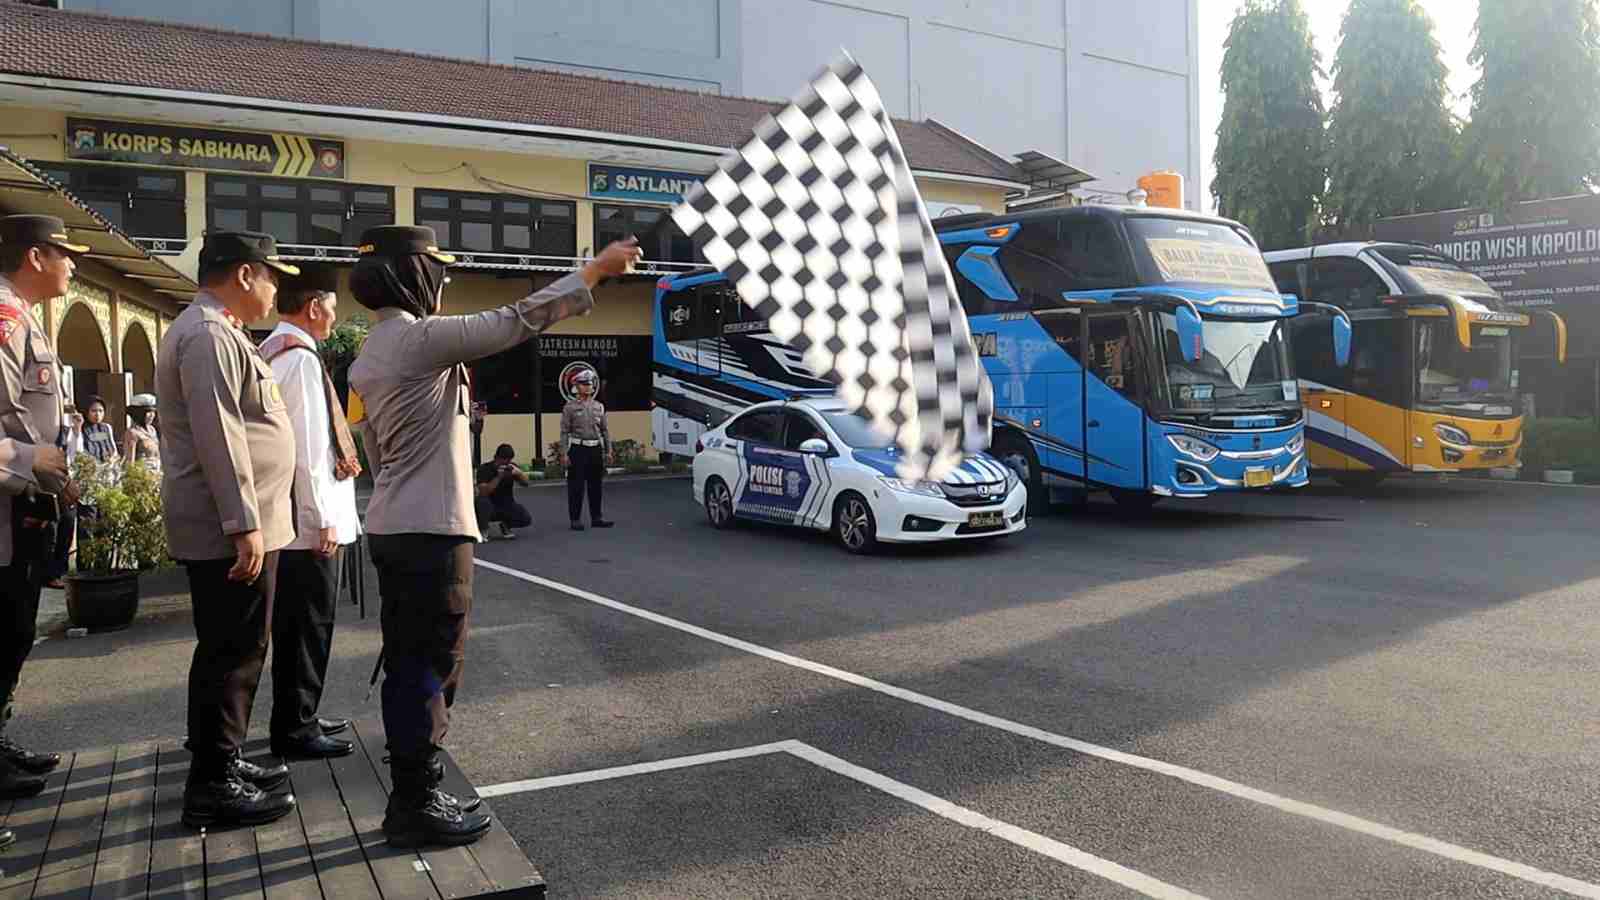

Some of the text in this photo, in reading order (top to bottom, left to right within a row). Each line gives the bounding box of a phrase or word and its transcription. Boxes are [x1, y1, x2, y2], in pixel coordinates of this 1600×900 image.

[103, 132, 272, 163] KORPS SABHARA
[1485, 234, 1527, 260] WISH
[750, 464, 784, 487] POLISI
